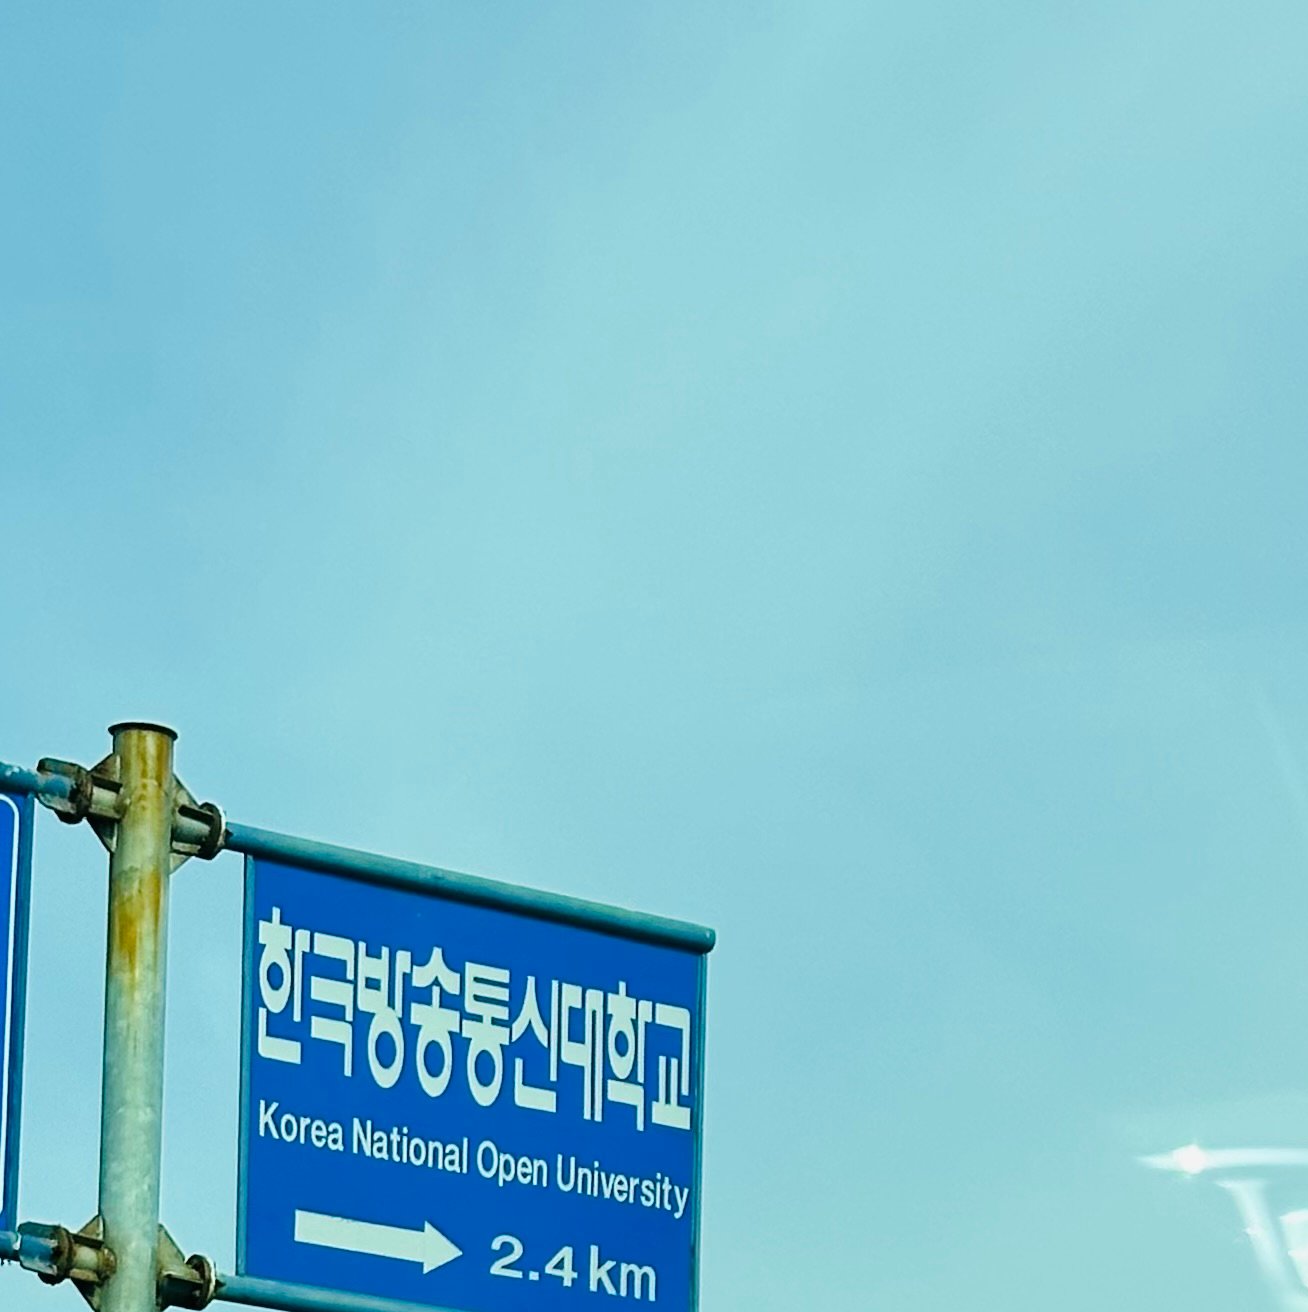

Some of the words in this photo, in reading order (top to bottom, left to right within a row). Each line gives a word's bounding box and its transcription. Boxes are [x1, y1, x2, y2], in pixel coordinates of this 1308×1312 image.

[258, 906, 692, 1132] 한국방송통신대학교
[258, 1100, 344, 1152] Korea
[352, 1122, 469, 1175] National
[476, 1140, 548, 1190] Open
[556, 1155, 689, 1220] University
